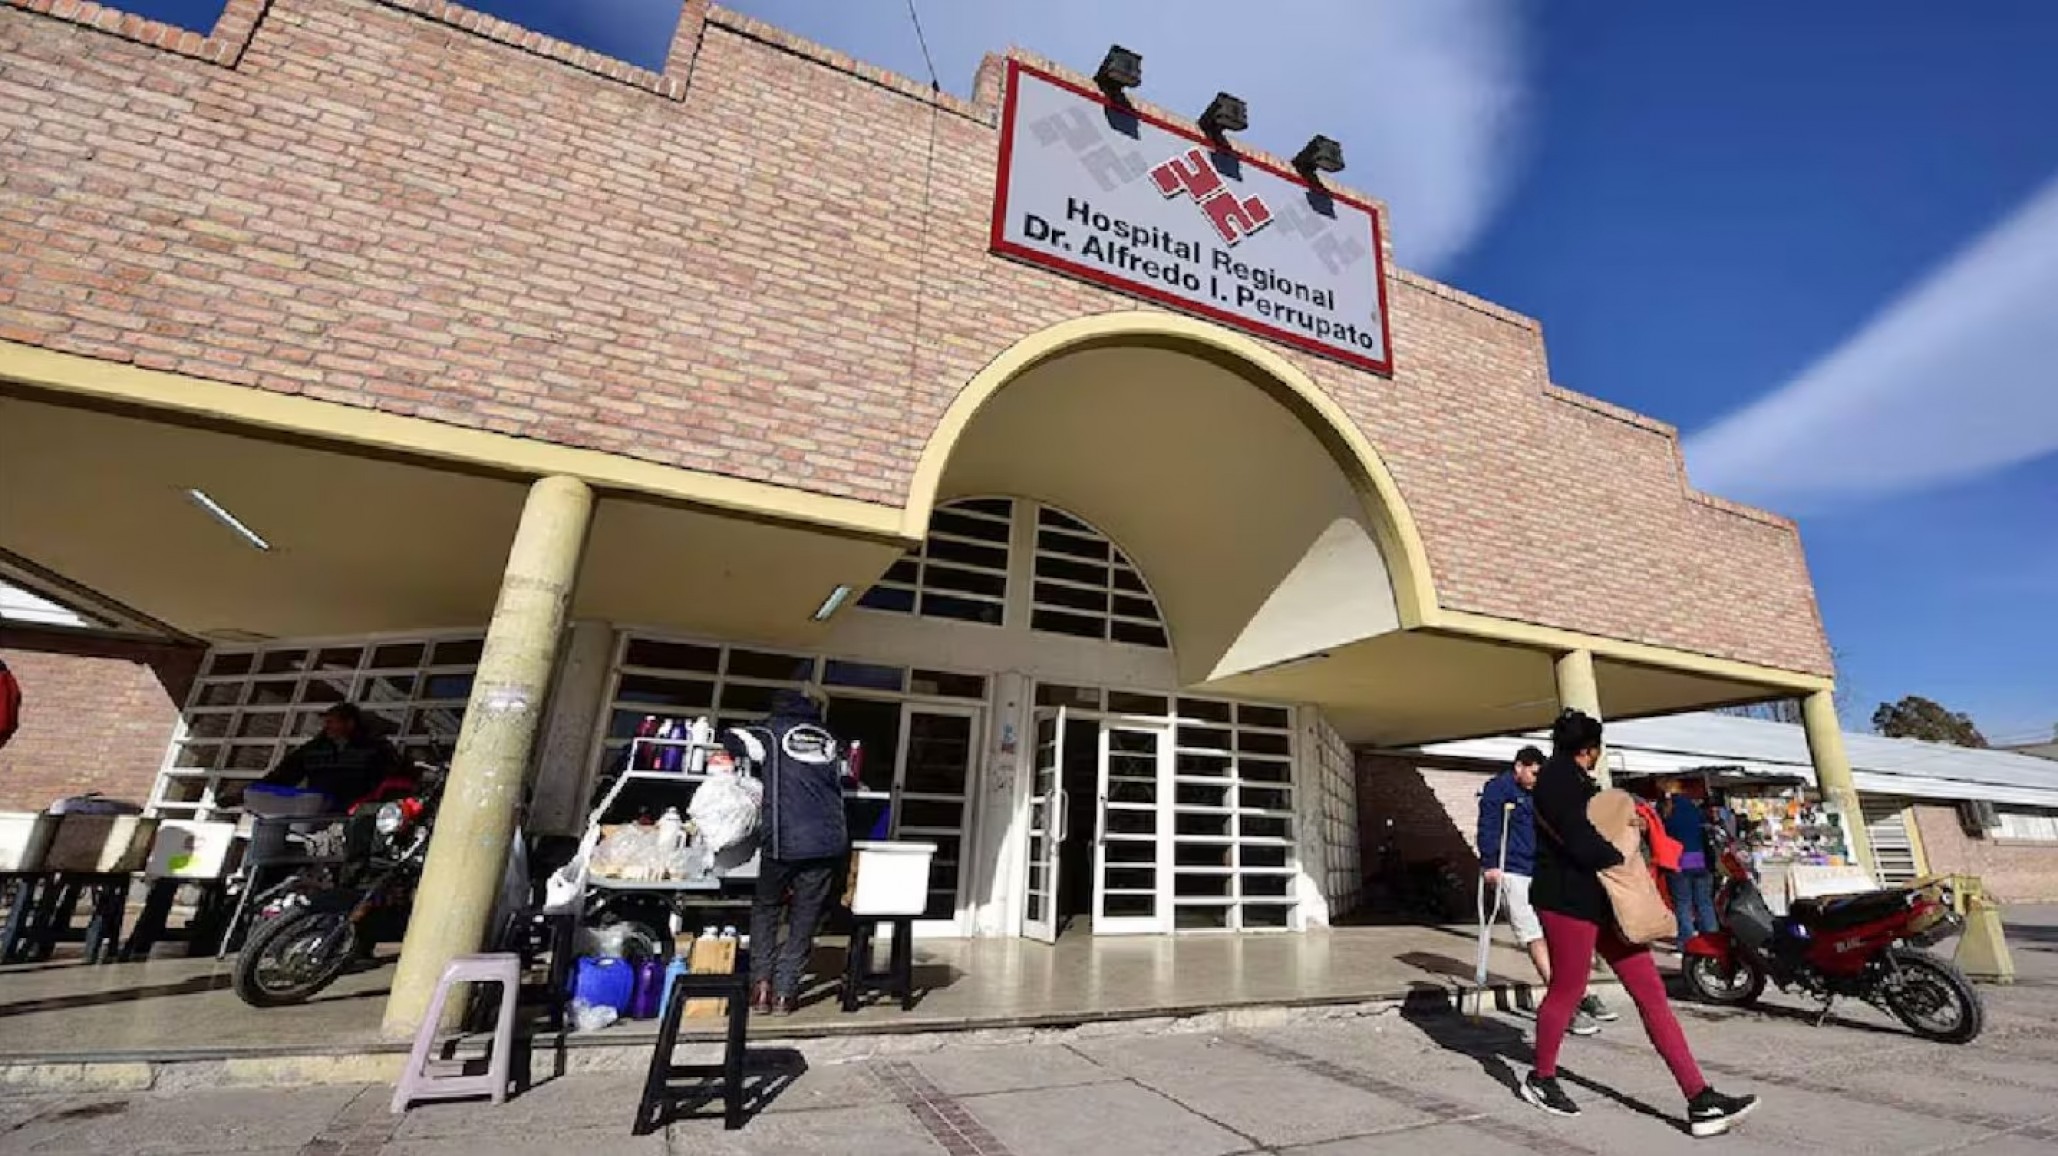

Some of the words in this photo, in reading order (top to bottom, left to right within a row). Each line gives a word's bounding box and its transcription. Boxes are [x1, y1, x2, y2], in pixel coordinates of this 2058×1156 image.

[1023, 212, 1072, 252] Dr.
[1081, 234, 1202, 292] Alfredo
[1210, 275, 1228, 302] I.
[1236, 284, 1374, 350] Perrupato
[1066, 197, 1201, 265] Hospital
[1212, 247, 1335, 311] Regional
